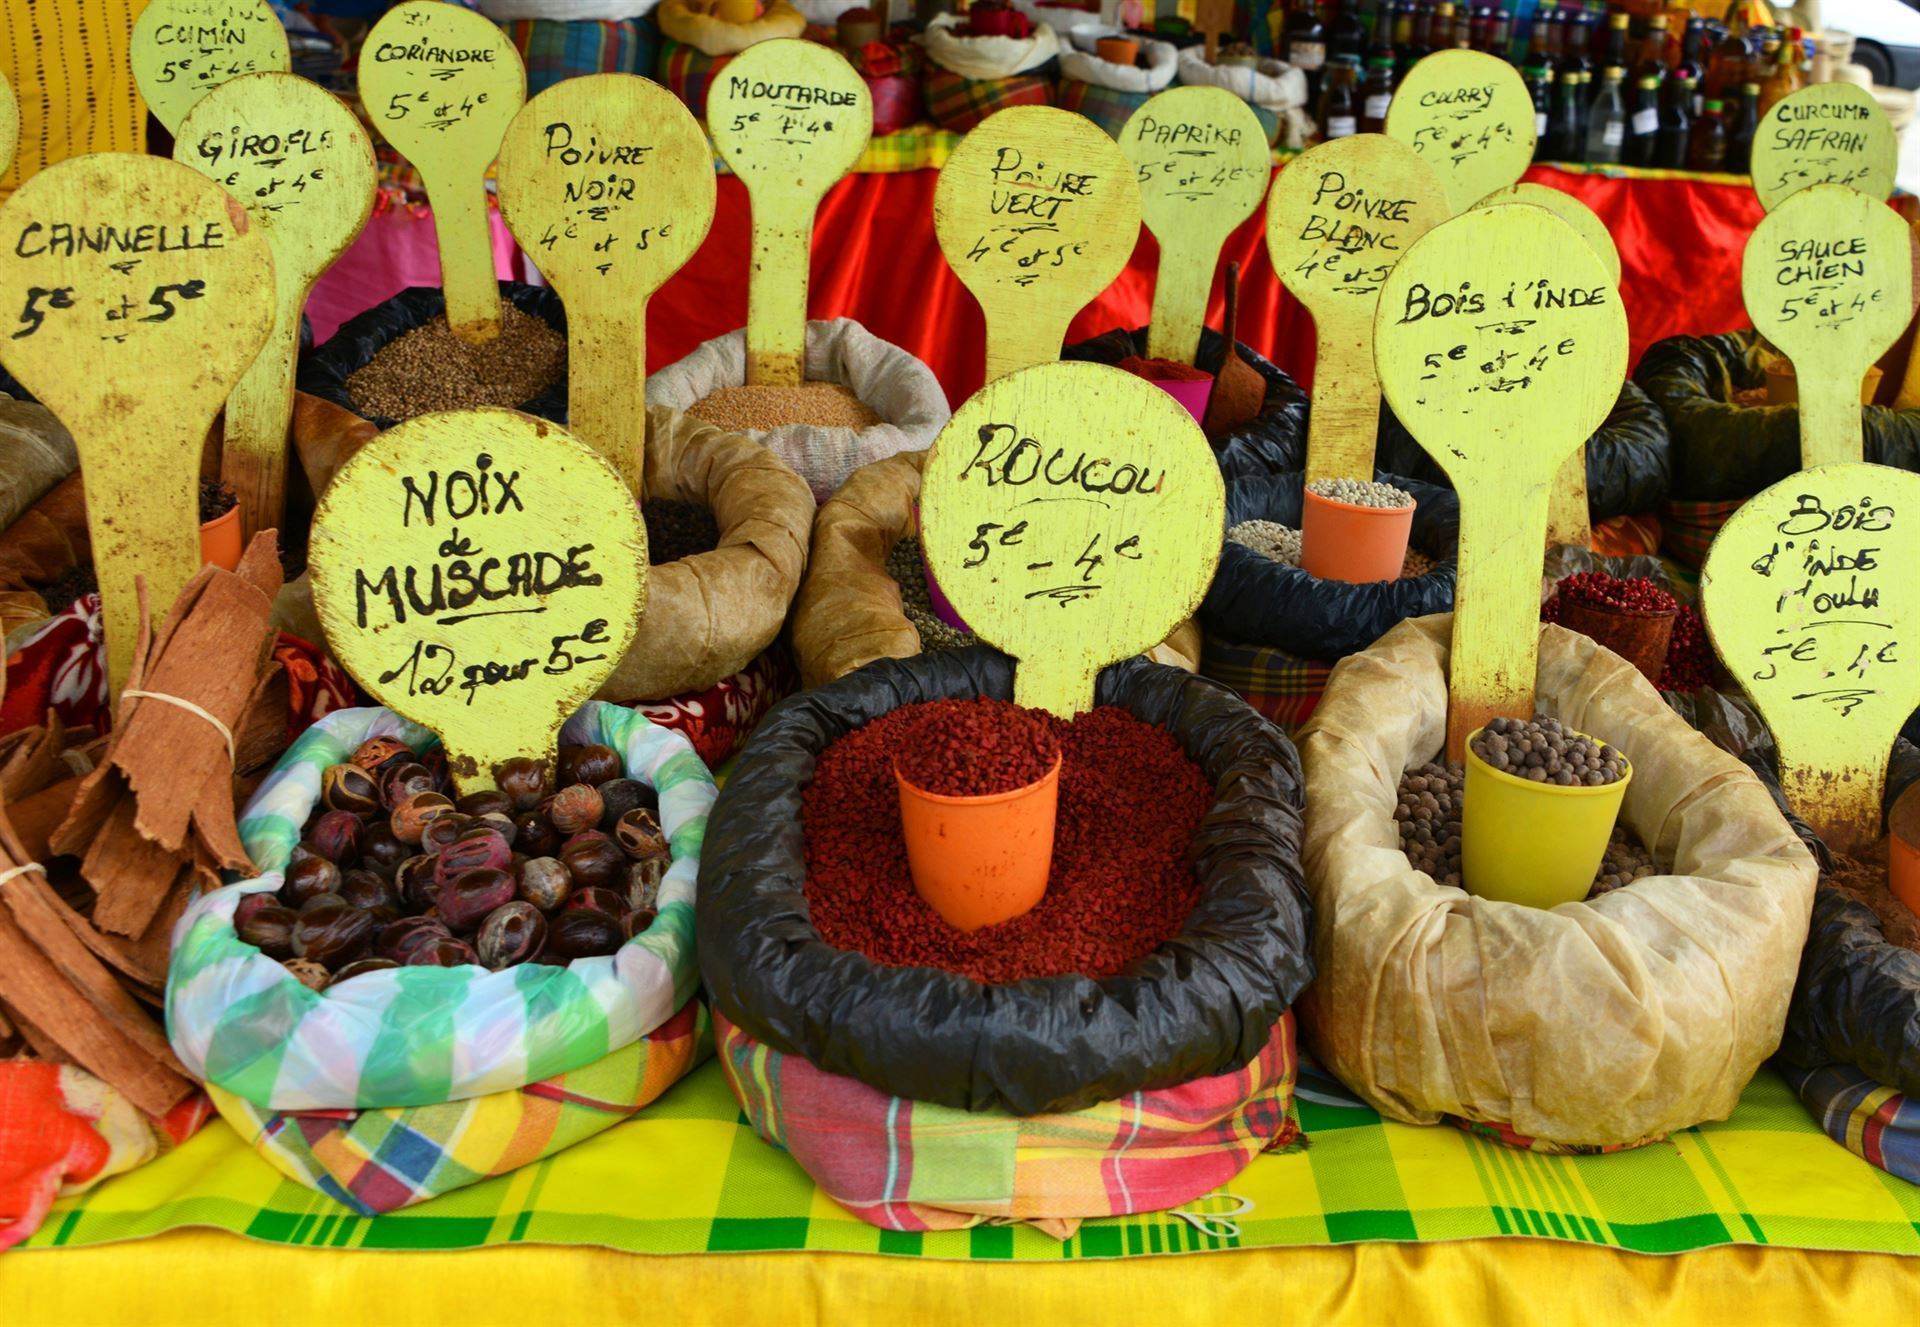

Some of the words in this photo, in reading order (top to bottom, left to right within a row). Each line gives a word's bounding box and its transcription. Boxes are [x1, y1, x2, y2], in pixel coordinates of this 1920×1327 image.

[729, 76, 857, 106] MOUTARDE
[1776, 103, 1870, 123] CURCUMA
[1771, 127, 1868, 154] SAFRAN
[991, 190, 1074, 220] VERT
[14, 220, 225, 259] CANNELLE
[1299, 214, 1400, 251] BLANC
[1776, 237, 1868, 263] SAUCE
[438, 526, 483, 559] de
[355, 542, 604, 630] MUSCADE
[378, 639, 455, 698] 12
[459, 657, 540, 707] pour
